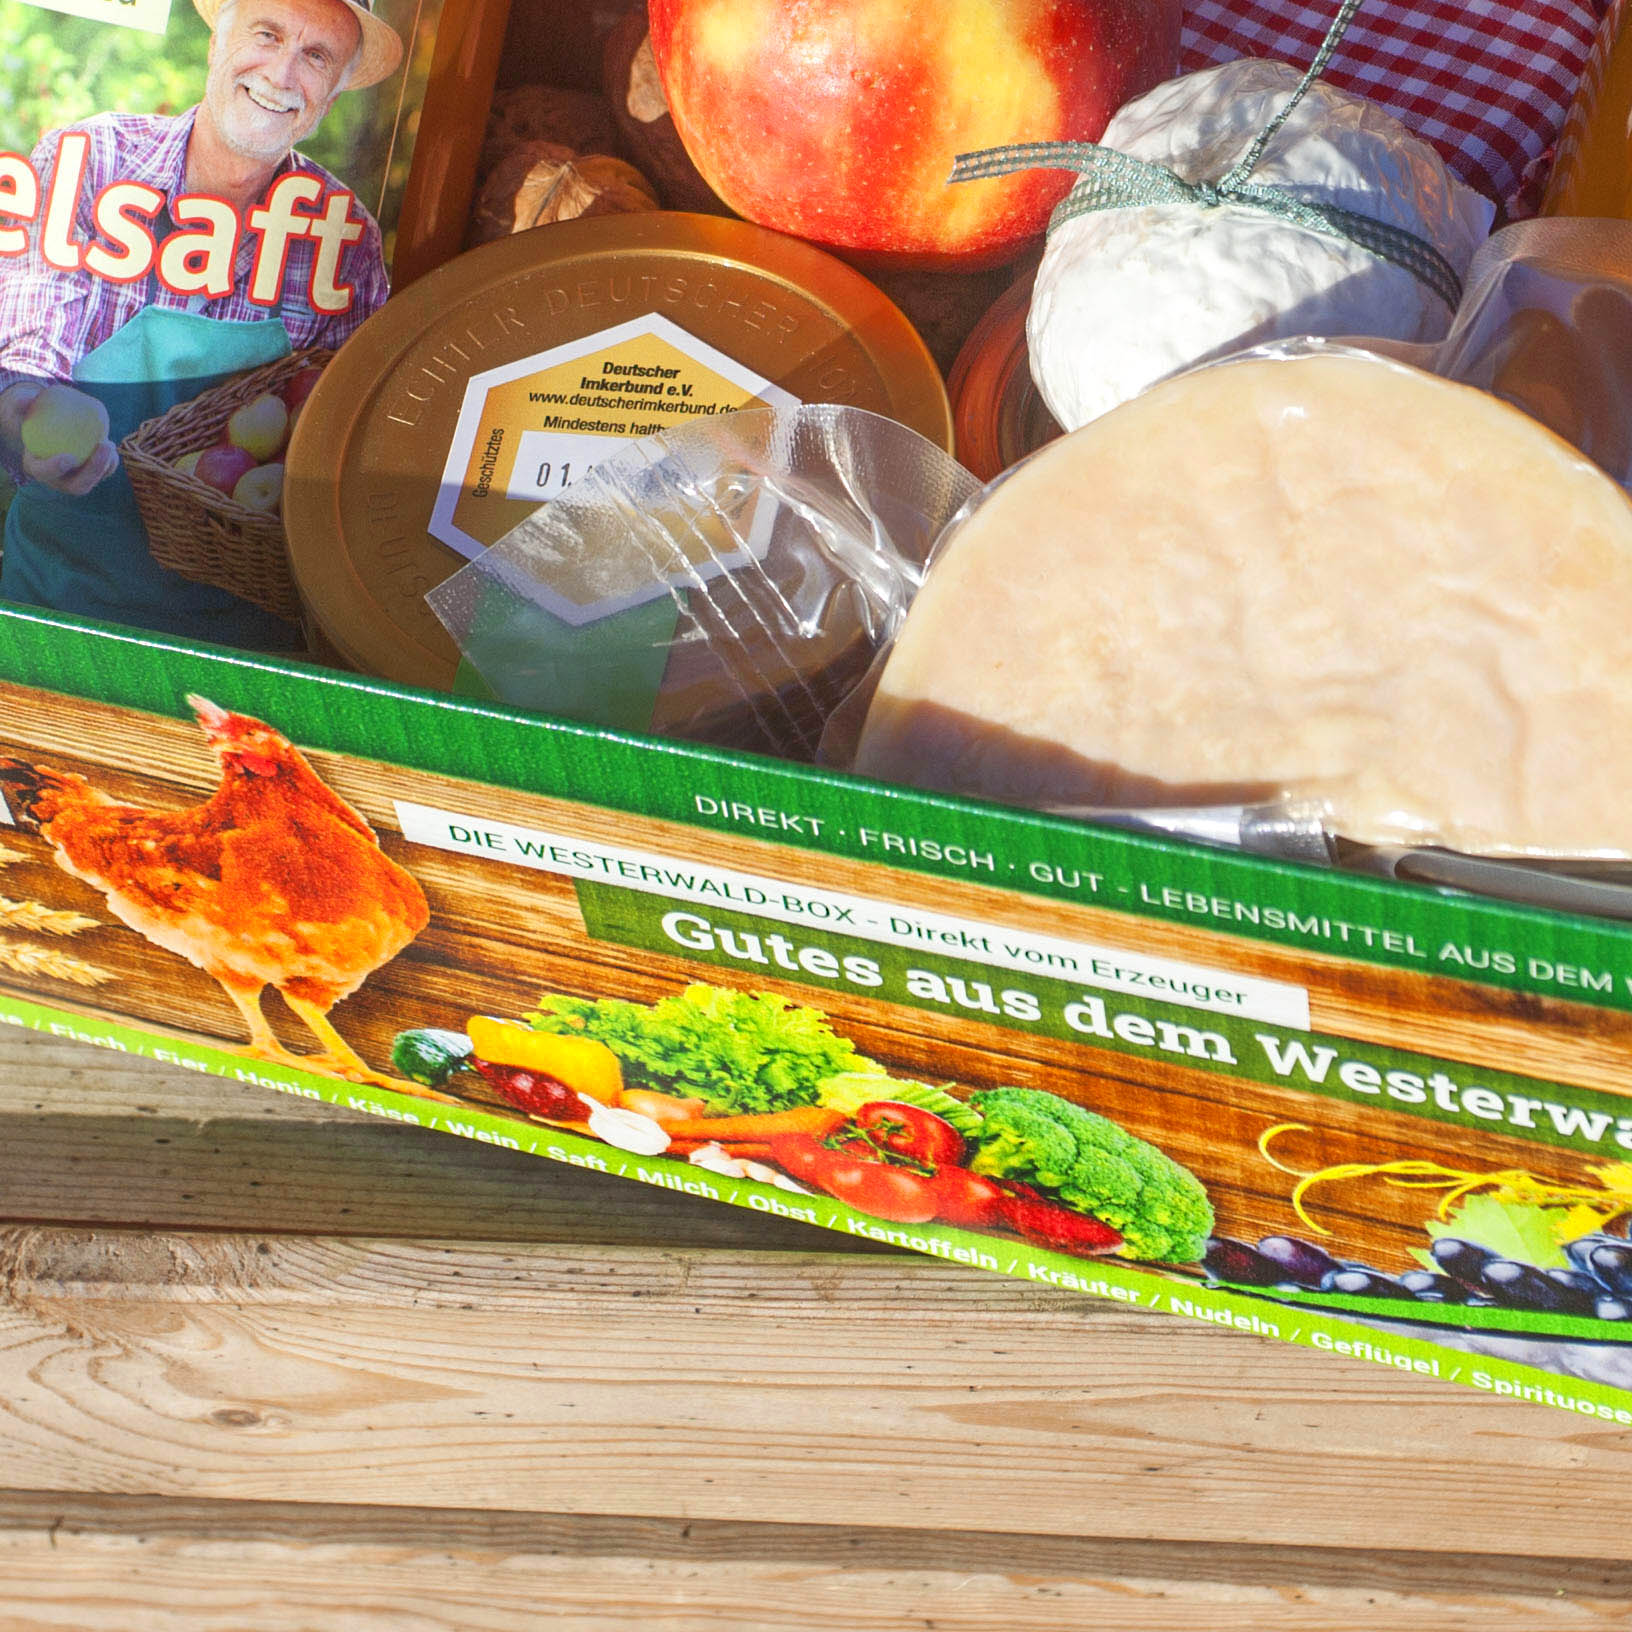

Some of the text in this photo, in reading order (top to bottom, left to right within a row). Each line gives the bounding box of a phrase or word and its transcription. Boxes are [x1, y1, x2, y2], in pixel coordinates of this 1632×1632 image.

[528, 390, 738, 416] www.deutscherimkerbund.de
[580, 376, 694, 398] Imkerbund e.V.
[602, 361, 681, 380] Deutscher
[543, 415, 627, 434] Mindestens
[472, 427, 505, 499] Geschütztes
[447, 823, 1249, 1007] DIE WESTERWALD-BOX Direkt vom Erzeuger
[694, 794, 825, 837] DIREKT
[860, 825, 996, 872] FRISCH
[1028, 861, 1104, 893] GUT
[1140, 883, 1427, 959] LEBENSMITTEL
[1438, 941, 1517, 975] AUS
[1528, 958, 1614, 994] DEM
[660, 911, 884, 989] Gutes
[904, 966, 1044, 1022] aus
[1063, 995, 1238, 1066] dem
[234, 1066, 323, 1103] Honig
[347, 1092, 422, 1127] Käse
[445, 1118, 522, 1150] Wein
[547, 1142, 610, 1171] Saft
[636, 1166, 720, 1204] Milch
[747, 1191, 819, 1227] Obst
[846, 1215, 1000, 1274] Kartoffeln
[1026, 1258, 1142, 1307] Kräuter
[1169, 1296, 1282, 1340] Nudeln
[1311, 1329, 1442, 1381] Geflügel
